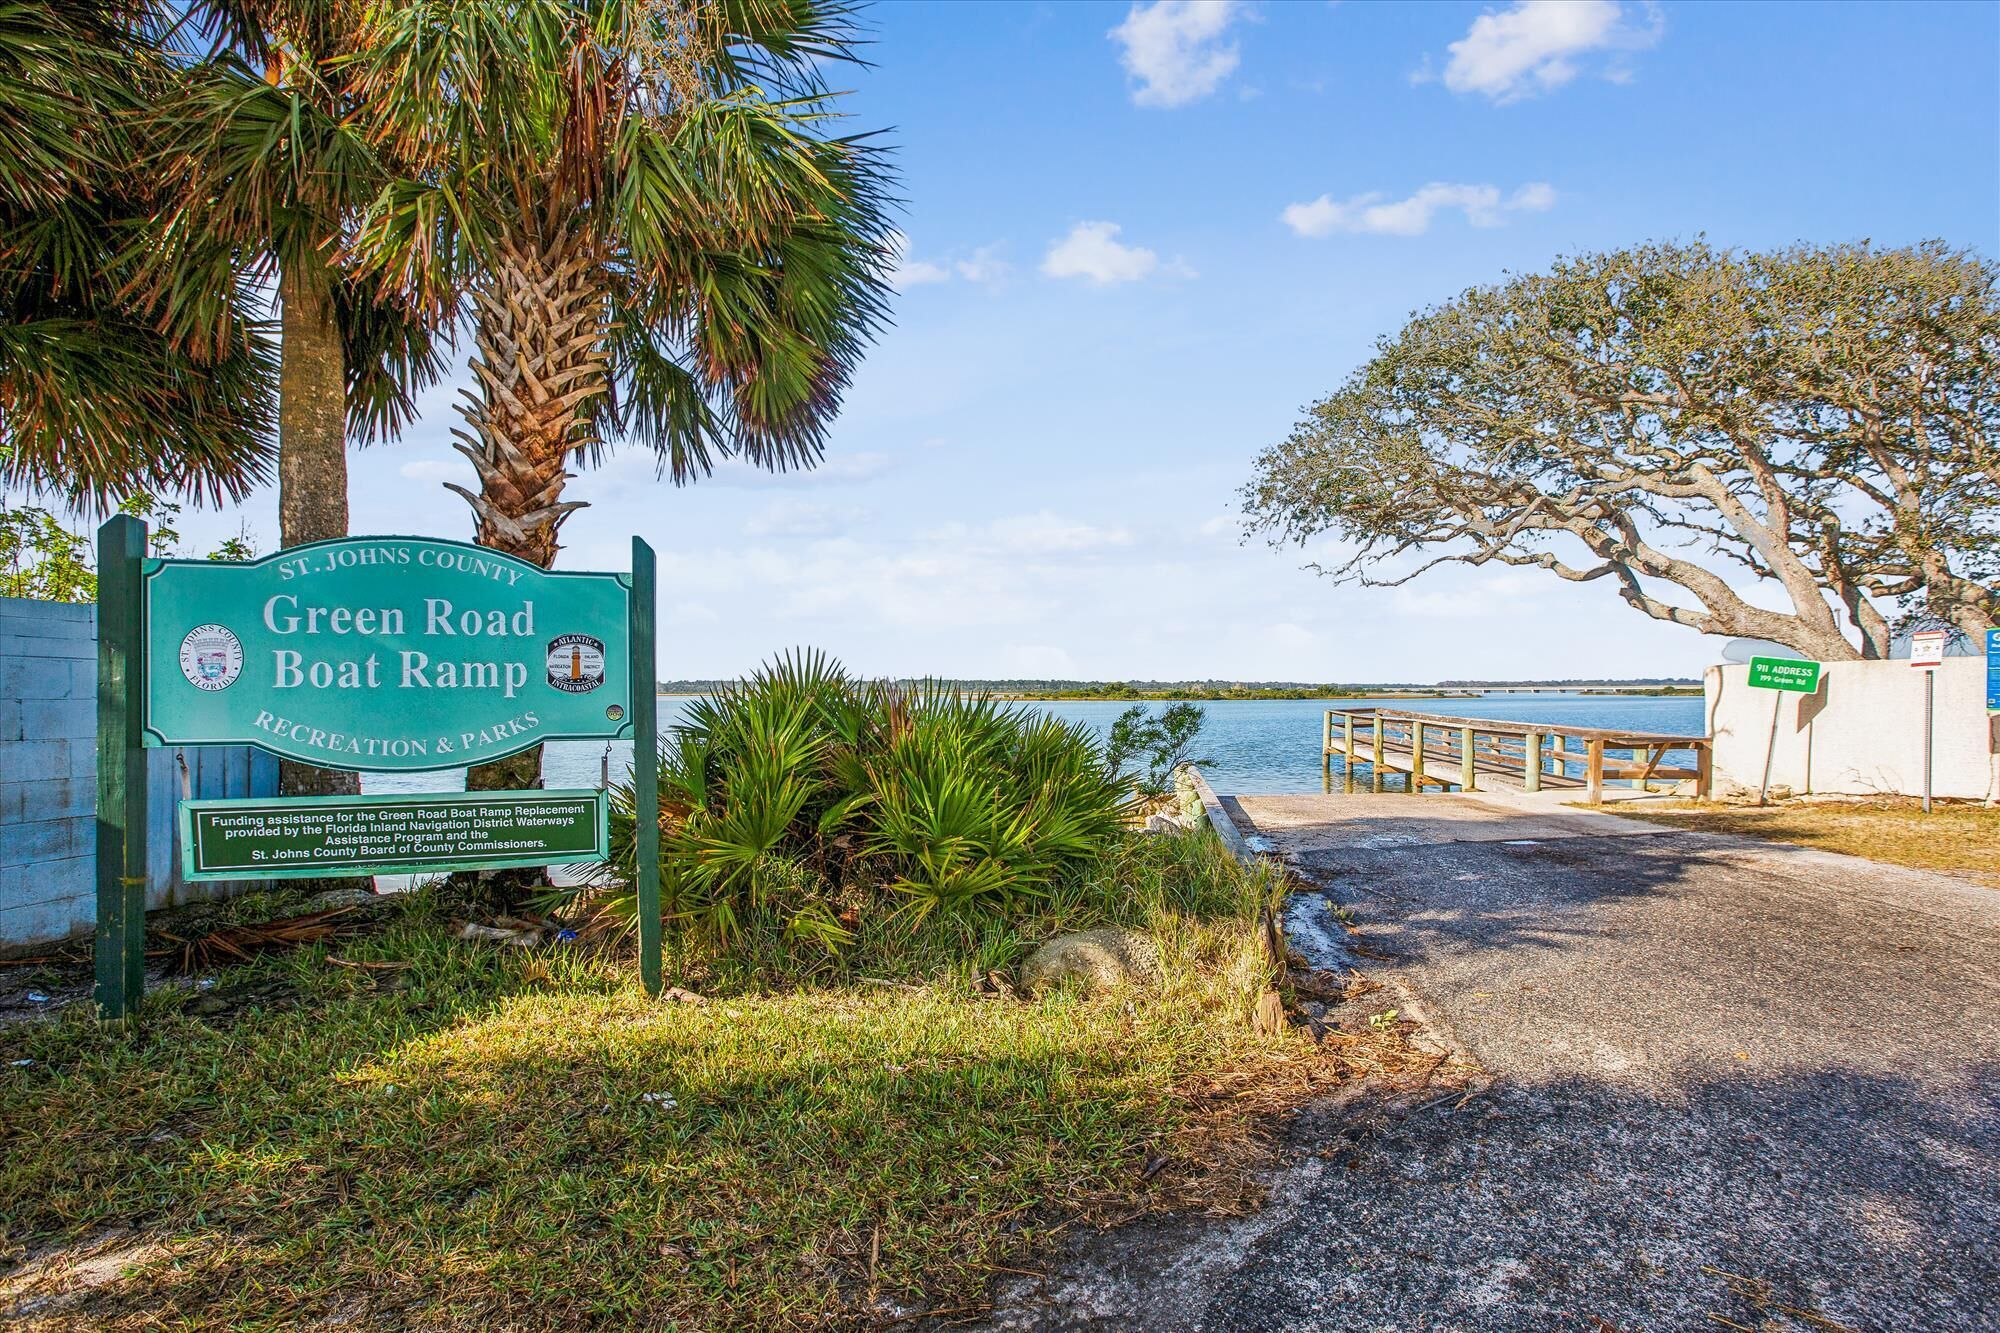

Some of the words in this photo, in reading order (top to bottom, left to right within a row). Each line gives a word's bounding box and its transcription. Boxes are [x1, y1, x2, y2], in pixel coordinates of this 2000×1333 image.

[279, 557, 320, 580] ST.
[326, 548, 411, 572] JOHNS
[418, 549, 524, 588] COUNTY
[263, 594, 406, 635] Green
[423, 598, 536, 636] Road
[184, 625, 214, 646] JOHNS
[218, 628, 242, 662] COUNTY
[558, 635, 594, 646] ATLANTIC
[190, 674, 236, 690] FLORIDA
[272, 650, 382, 688] Boat
[398, 650, 528, 698] Ramp
[1756, 664, 1770, 672] 911
[1772, 666, 1814, 677] ADDRESS
[551, 679, 601, 692] INTRACOASTAL
[253, 708, 428, 756] RECREATION
[436, 736, 454, 753] &
[460, 710, 540, 750] PARKS
[211, 816, 264, 828] Funding
[267, 814, 334, 826] assistance
[336, 812, 354, 823] for
[356, 811, 376, 822] the
[378, 810, 414, 821] Green
[417, 808, 448, 820] Road
[450, 808, 476, 818] Boat
[480, 806, 512, 819] Ramp
[514, 804, 585, 817] Replacement
[225, 826, 280, 840] provided
[284, 826, 299, 838] by
[302, 824, 322, 835] the
[325, 823, 367, 834] Florida
[370, 822, 406, 832] Inland
[410, 820, 470, 832] Navigation
[473, 818, 514, 828] District
[516, 816, 575, 827] Waterways
[252, 850, 269, 860] St.
[272, 848, 310, 859] Johns
[313, 846, 357, 858] County
[360, 844, 396, 856] Board
[398, 844, 411, 854] of
[413, 842, 455, 854] County
[458, 839, 548, 851] Commissioners.
[325, 834, 391, 846] Assistance
[394, 832, 444, 844] Program
[446, 830, 468, 840] and
[470, 830, 489, 840] the
